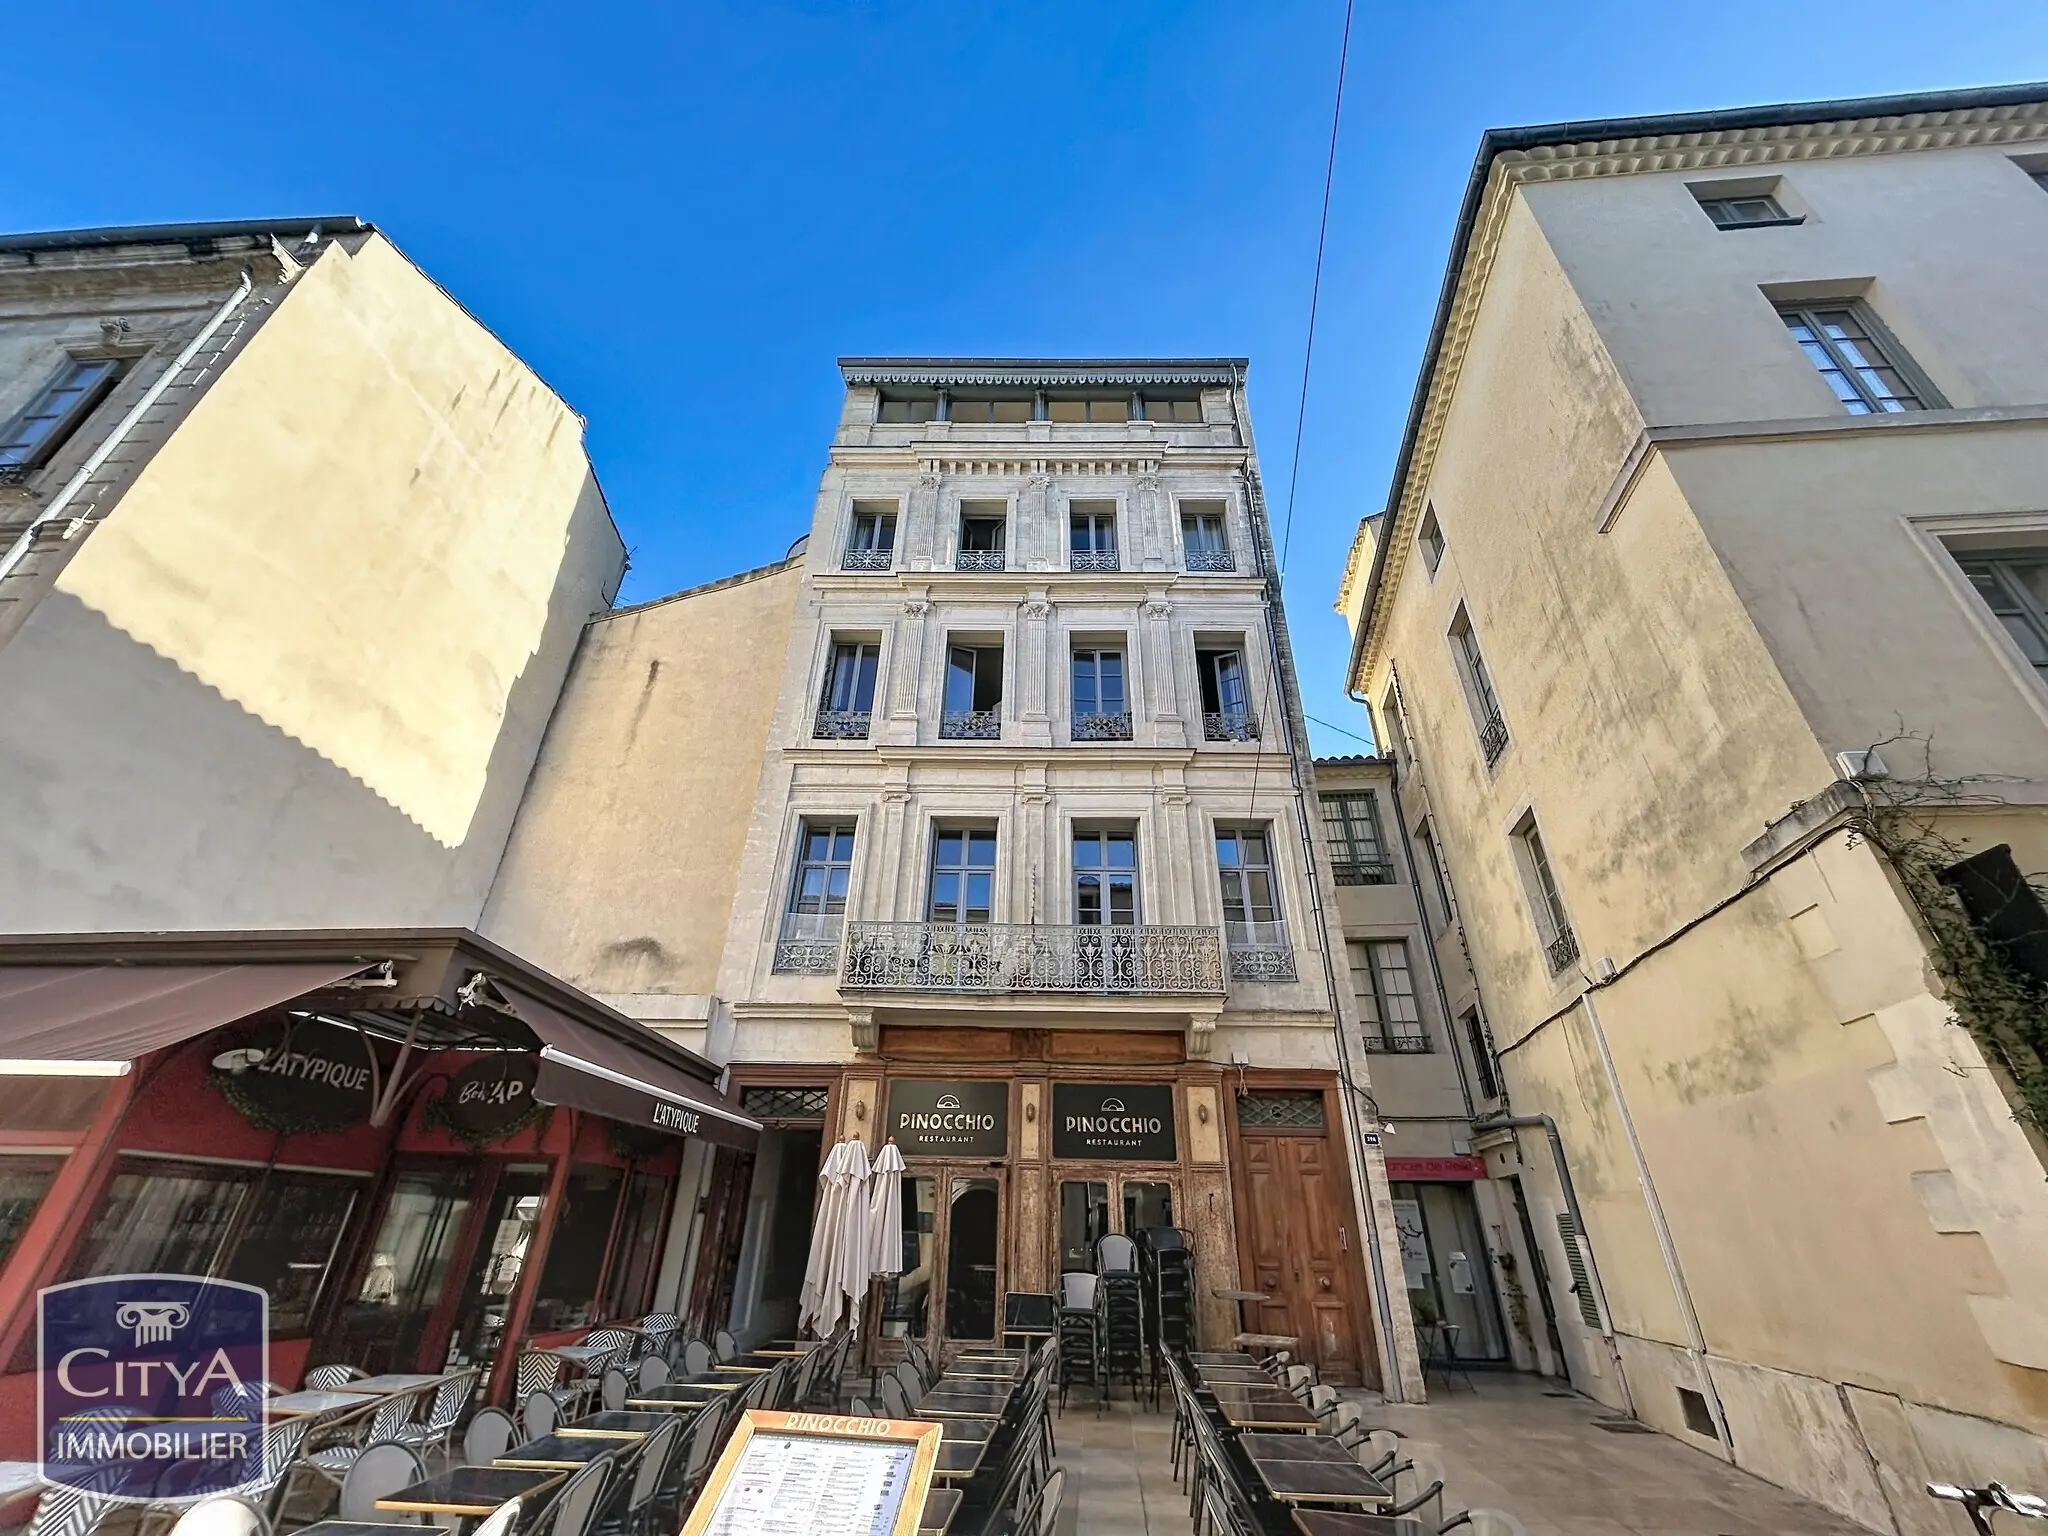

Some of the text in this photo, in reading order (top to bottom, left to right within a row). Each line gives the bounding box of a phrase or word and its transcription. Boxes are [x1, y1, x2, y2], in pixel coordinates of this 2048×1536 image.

[257, 1047, 370, 1091] LATYPIQUE
[653, 1102, 700, 1133] L'ATYPIQUE
[899, 1113, 995, 1131] PINOCCHIO
[1065, 1116, 1162, 1134] PINOCCHIO
[918, 1135, 975, 1143] RESTAURANT
[1086, 1138, 1142, 1147] RESTAURANT
[784, 1414, 891, 1436] PINOCCHIO
